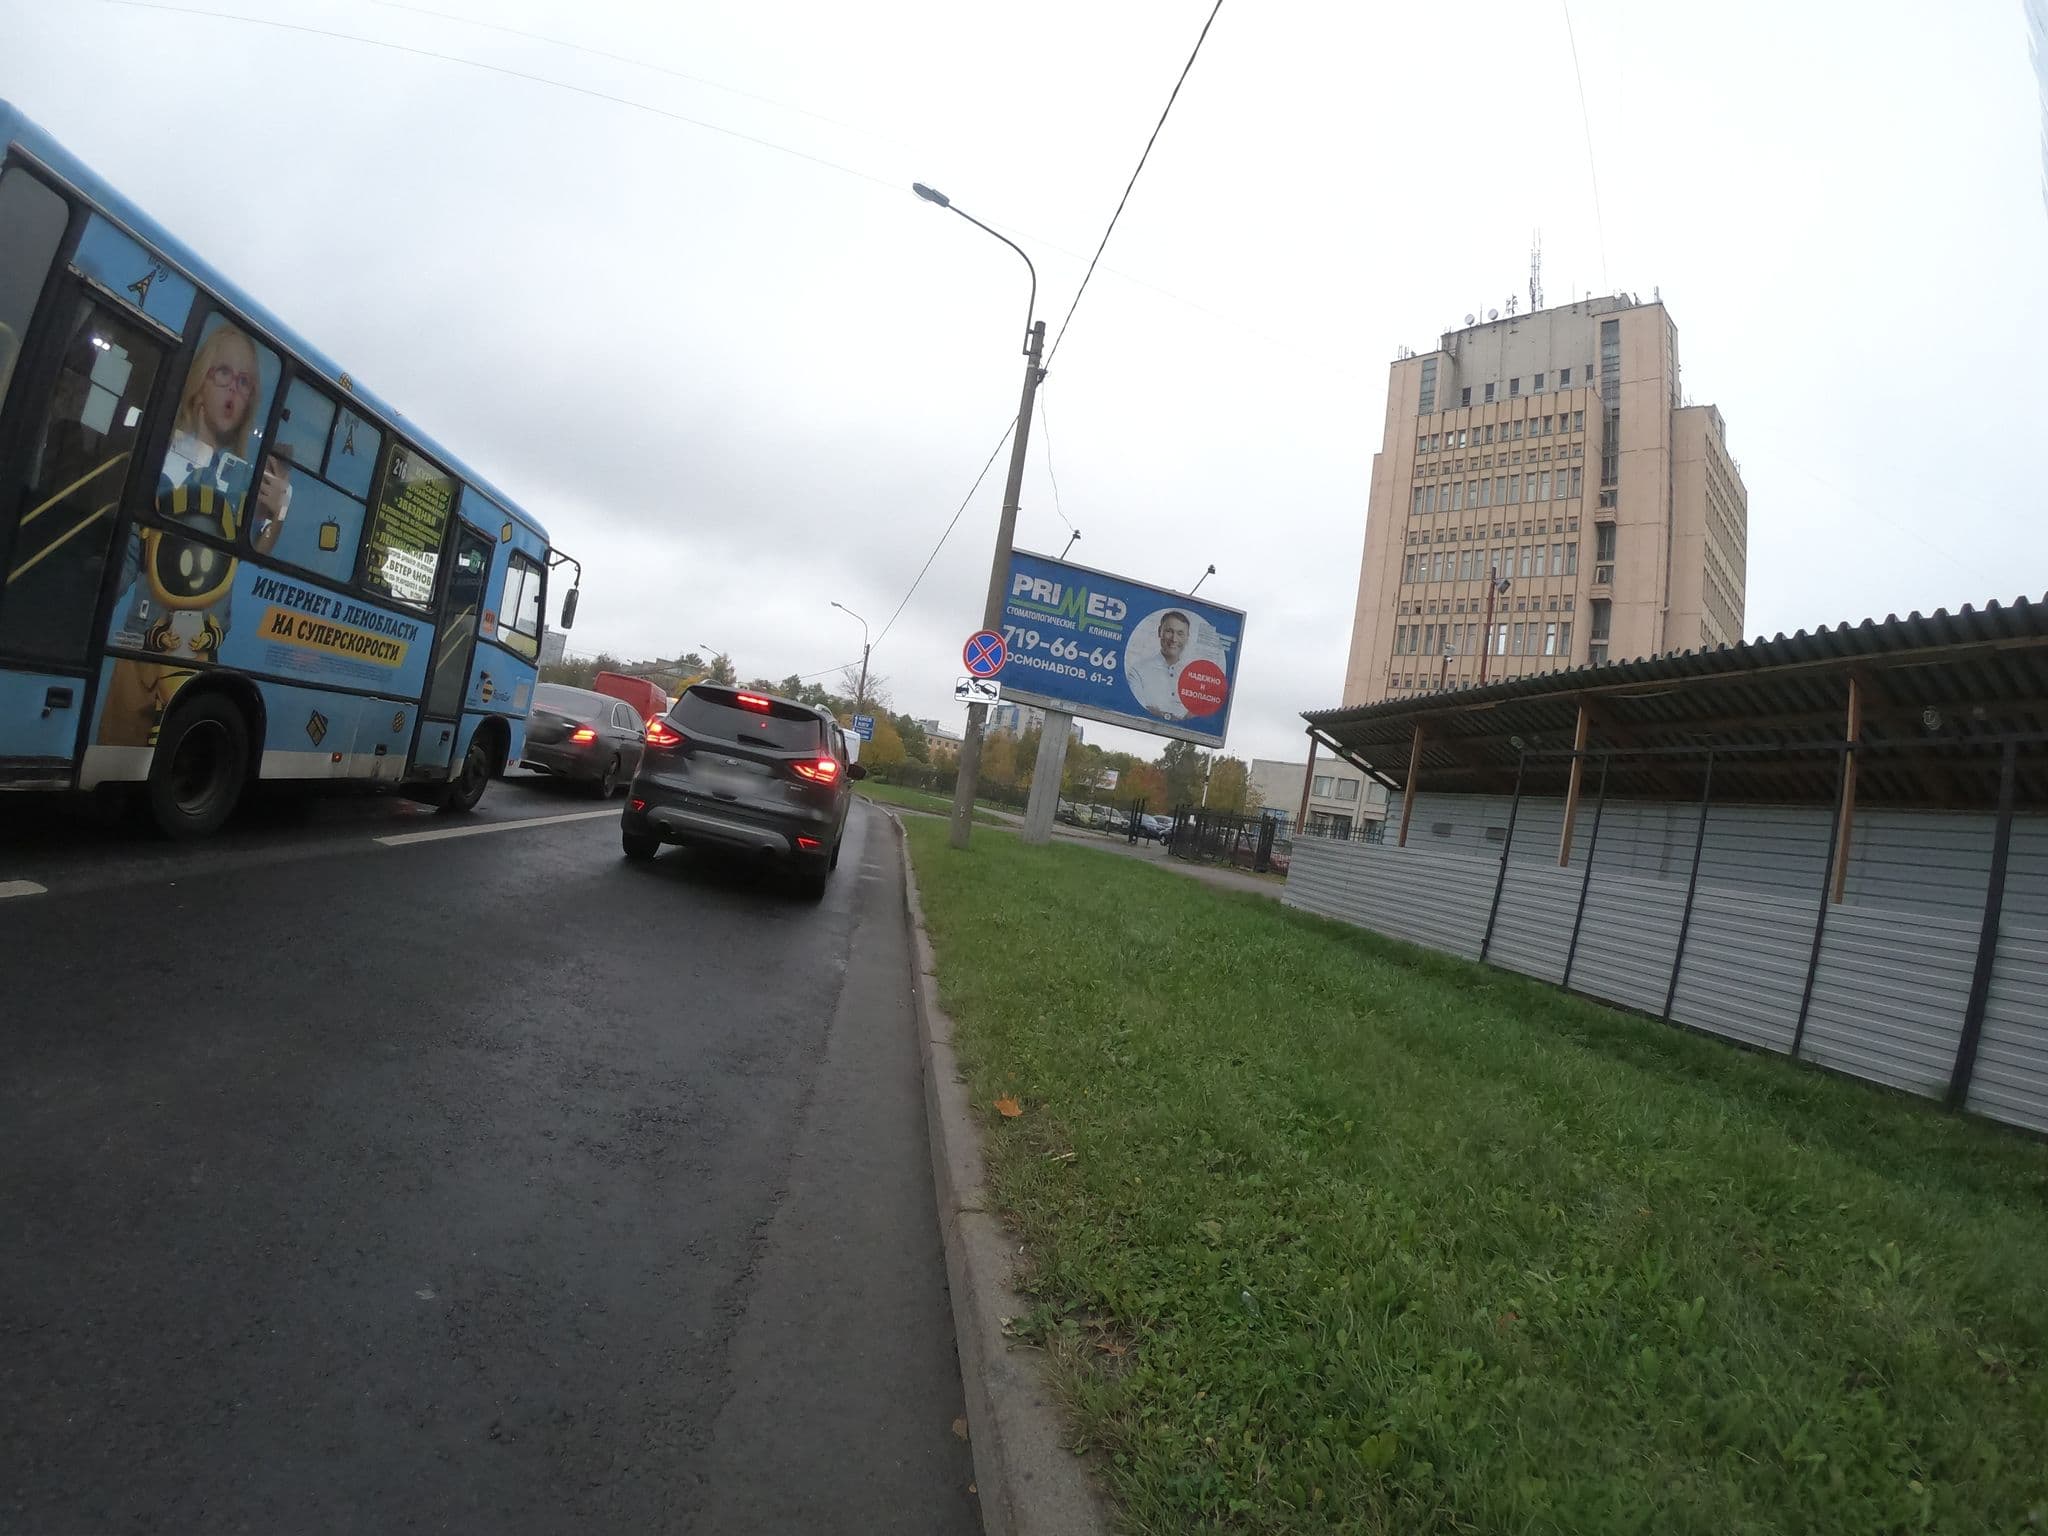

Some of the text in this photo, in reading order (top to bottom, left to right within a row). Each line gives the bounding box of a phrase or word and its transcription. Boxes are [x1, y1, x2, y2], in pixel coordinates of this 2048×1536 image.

[392, 457, 408, 479] 216
[252, 575, 331, 617] ИНТЕРНЕТ
[331, 600, 343, 619] В
[342, 604, 419, 641] ЛЕНОБЛАСТИ
[1012, 573, 1127, 621] PRIMED
[271, 613, 400, 661] НА СУПЕРСКОРОСТИ
[1006, 605, 1122, 641] СТОМАТОЛОГИЧЕСКИЕ КЛИНИКИ
[1003, 624, 1117, 670] 719-66-66
[1090, 672, 1114, 686] 61-2
[1181, 688, 1222, 704] БЕЗОПАСНО
[1188, 671, 1222, 686] НАДЕЖНО
